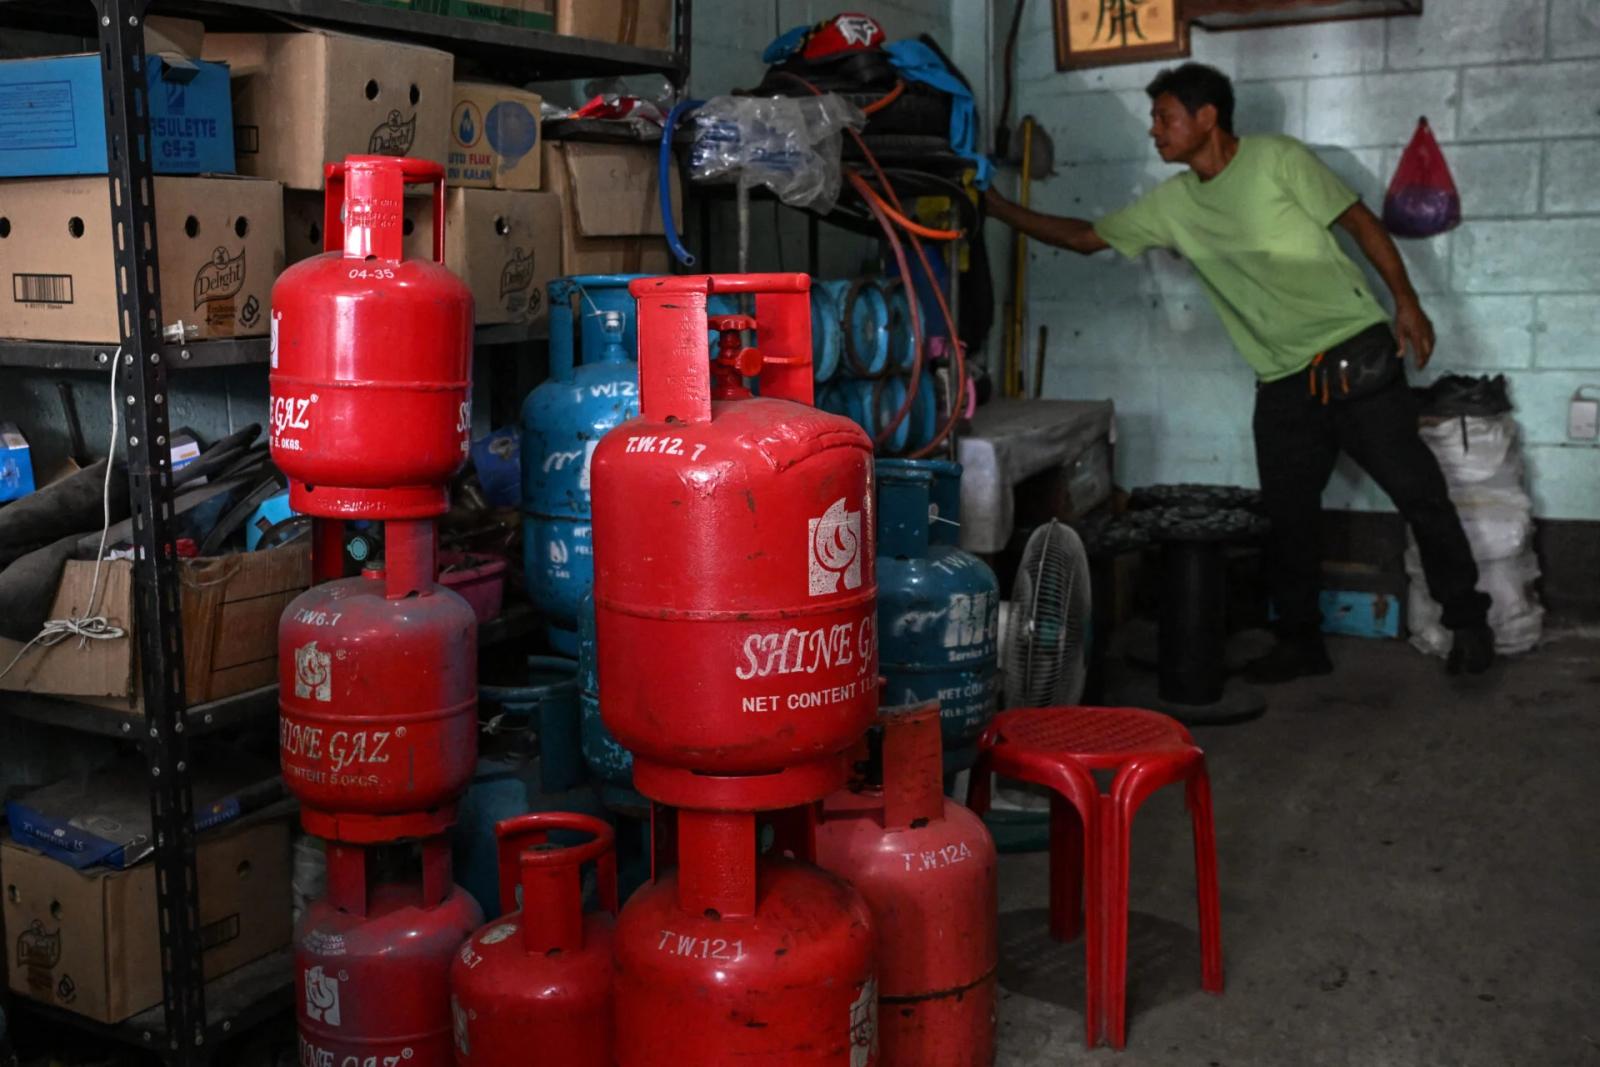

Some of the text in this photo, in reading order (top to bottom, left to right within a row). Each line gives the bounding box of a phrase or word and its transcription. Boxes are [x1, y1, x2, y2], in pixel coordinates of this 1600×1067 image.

[200, 264, 241, 295] Delight
[348, 268, 394, 280] 04-35
[275, 396, 310, 437] GAZ
[735, 623, 854, 680] SHINE
[742, 695, 780, 713] NET
[787, 682, 857, 710] CONTENT
[329, 730, 391, 773] GAZ
